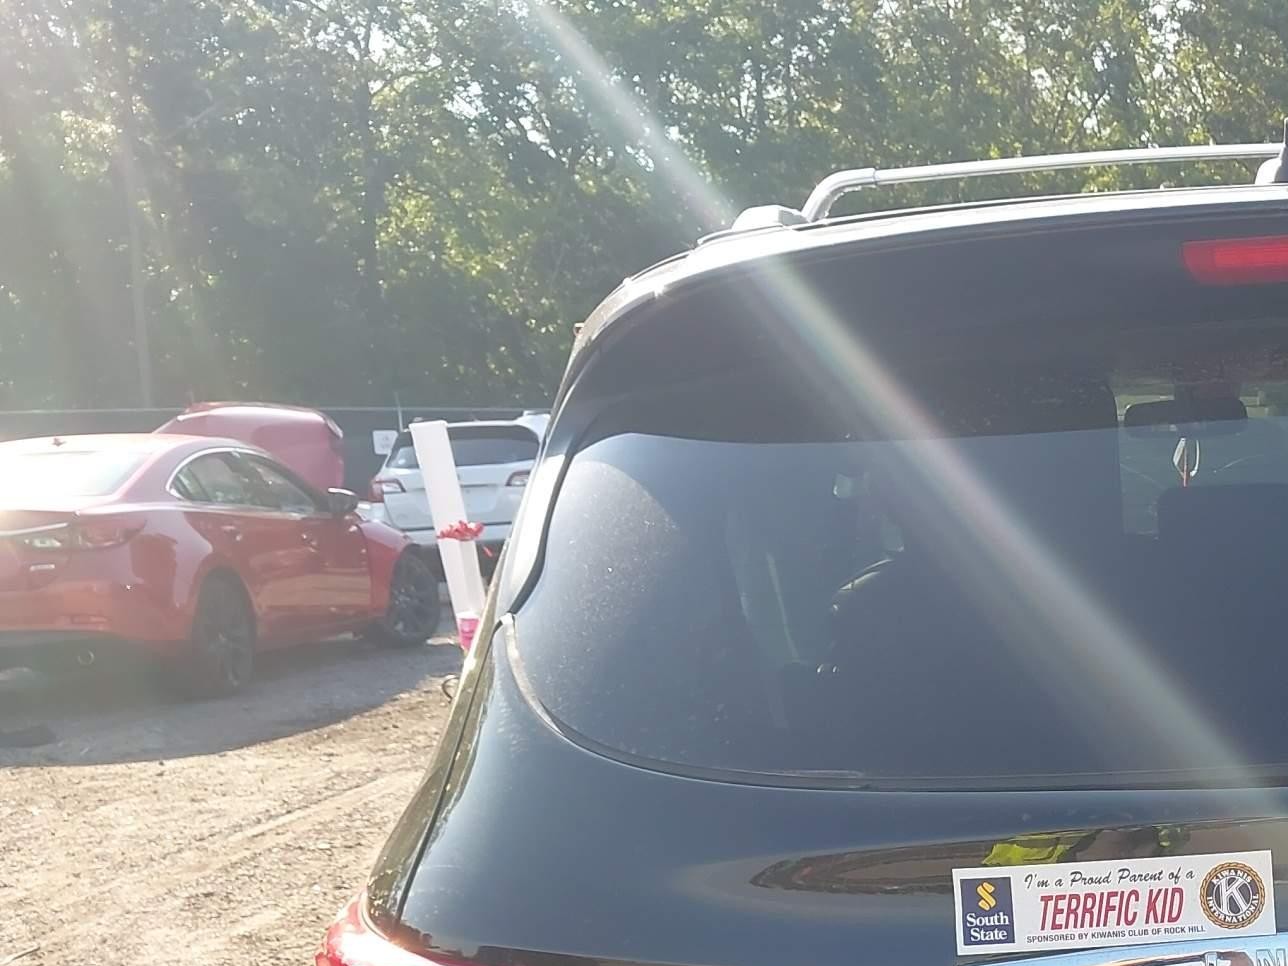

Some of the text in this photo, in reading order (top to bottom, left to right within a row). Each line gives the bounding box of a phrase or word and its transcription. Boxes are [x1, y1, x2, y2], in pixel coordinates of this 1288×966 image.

[1024, 866, 1195, 889] I'm a Proud Parent of a
[1210, 869, 1253, 885] KIWANIS
[1040, 887, 1184, 931] TERRIFIC KID
[1206, 893, 1259, 923] INTERNATIONAL
[966, 911, 1009, 927] South
[970, 927, 1008, 942] State
[1026, 925, 1206, 944] SPONSORED BY KIWANIS CLUB OF ROCK HILL
